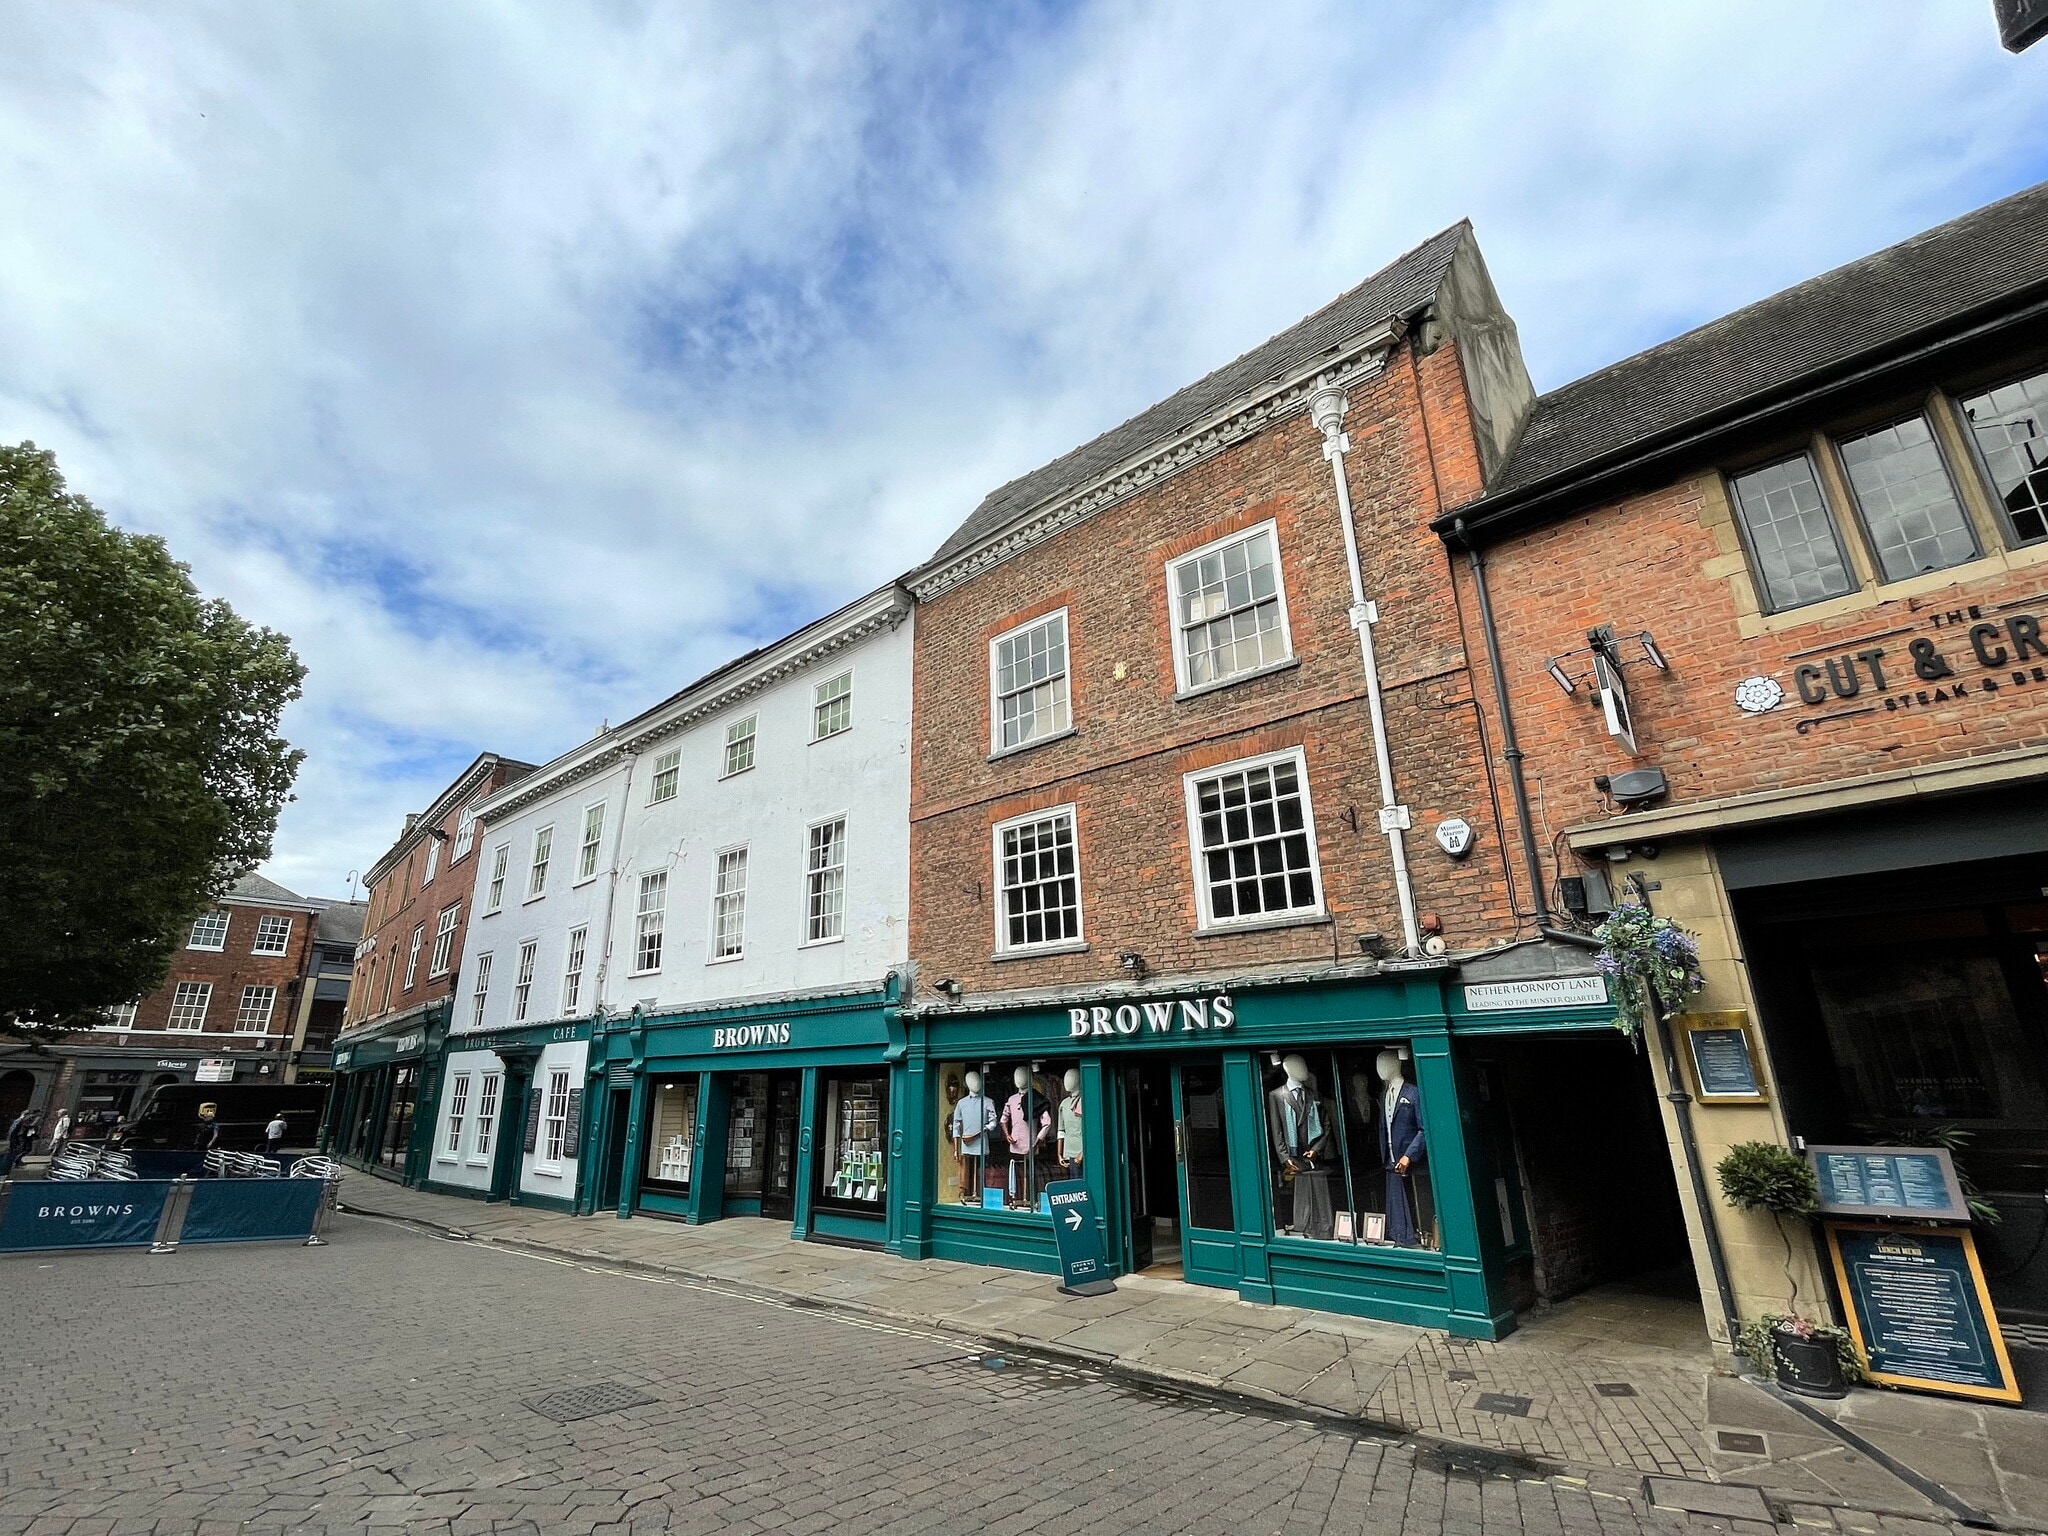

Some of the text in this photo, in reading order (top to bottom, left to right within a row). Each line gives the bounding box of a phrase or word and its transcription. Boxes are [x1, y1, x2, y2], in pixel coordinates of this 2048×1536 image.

[1929, 605, 1982, 628] THE
[1793, 614, 2048, 704] CUT & CR
[1884, 682, 1969, 711] STEAK
[1982, 678, 1999, 691] &
[1469, 979, 1598, 996] NETHER HORNPOT LANE
[1530, 997, 1563, 1005] MINSTER
[1564, 994, 1601, 1003] QUARTER
[1068, 996, 1235, 1037] BROWNS
[712, 1022, 790, 1048] BROWNS
[1051, 1191, 1088, 1206] ENTRANCE
[38, 1204, 133, 1218] BROWNS
